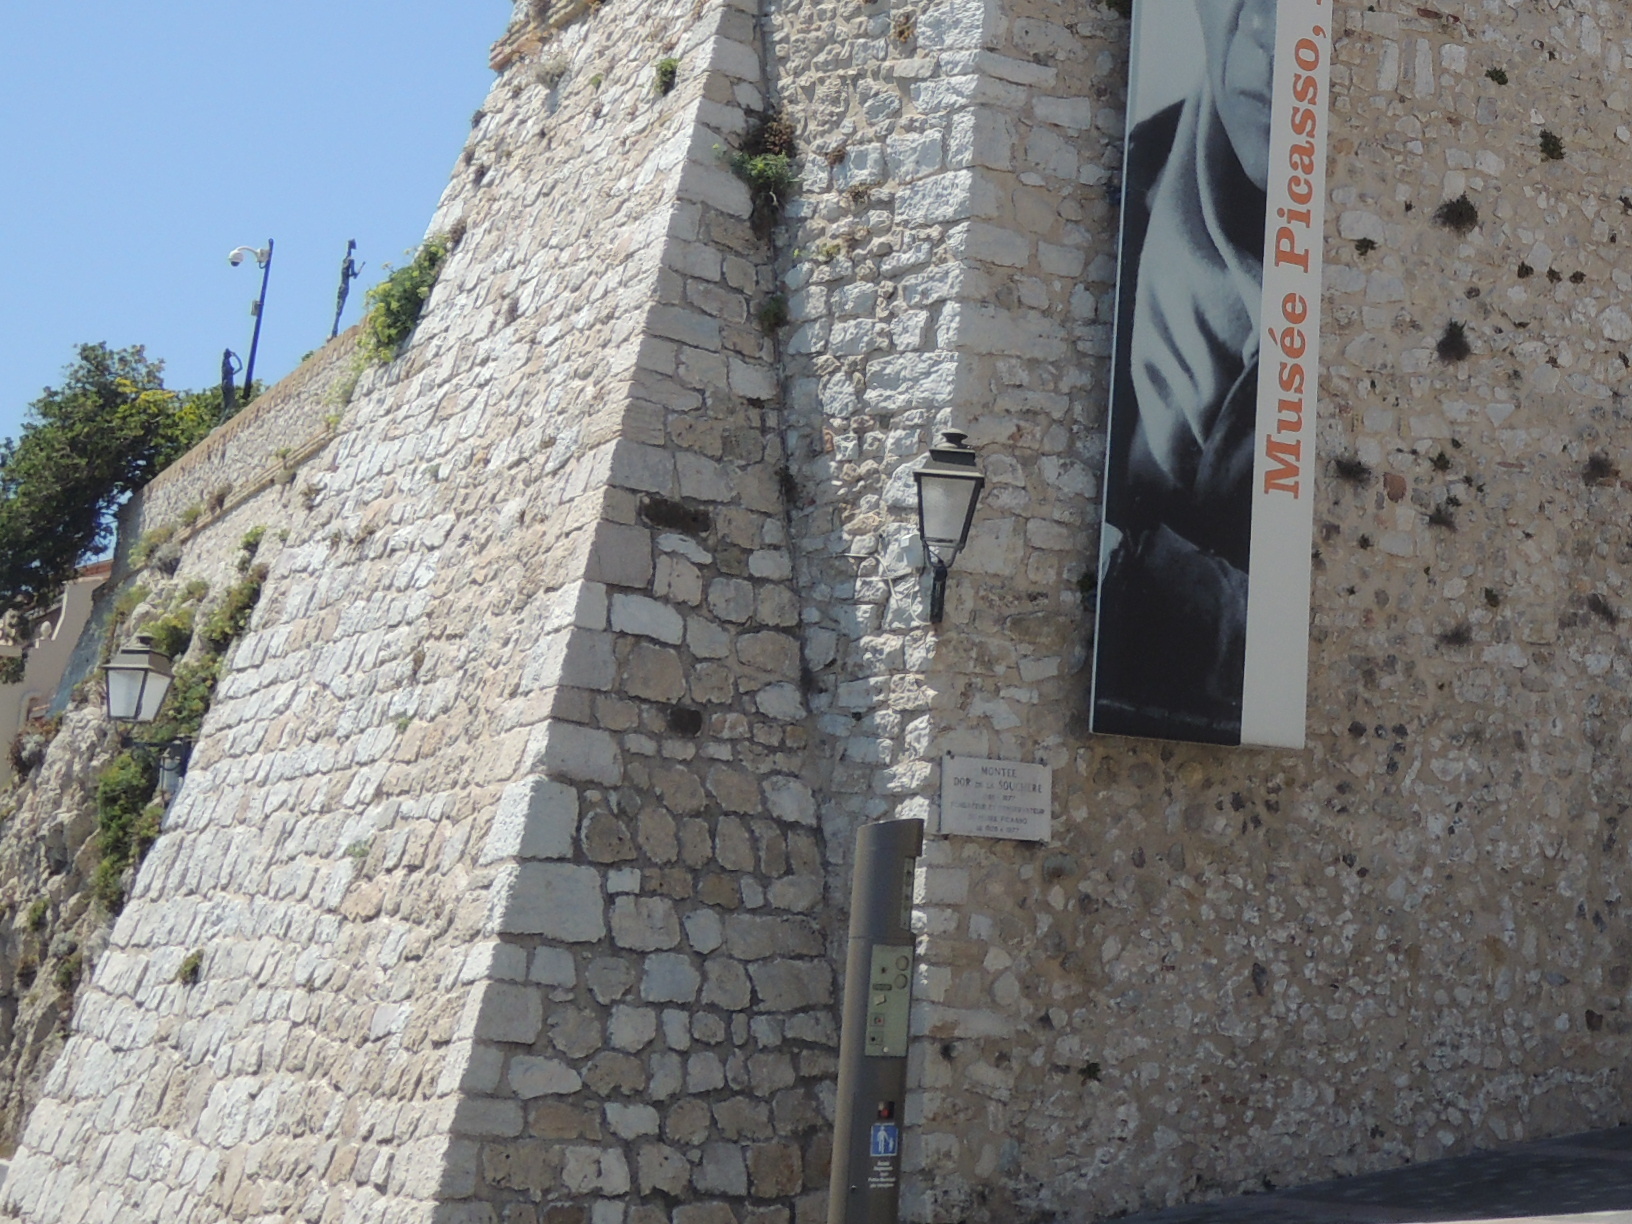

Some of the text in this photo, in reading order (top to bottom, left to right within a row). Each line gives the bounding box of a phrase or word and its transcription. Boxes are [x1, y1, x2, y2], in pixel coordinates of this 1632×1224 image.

[1275, 25, 1327, 274] Picasso,
[1264, 292, 1307, 499] Musée
[953, 777, 972, 787] DOR
